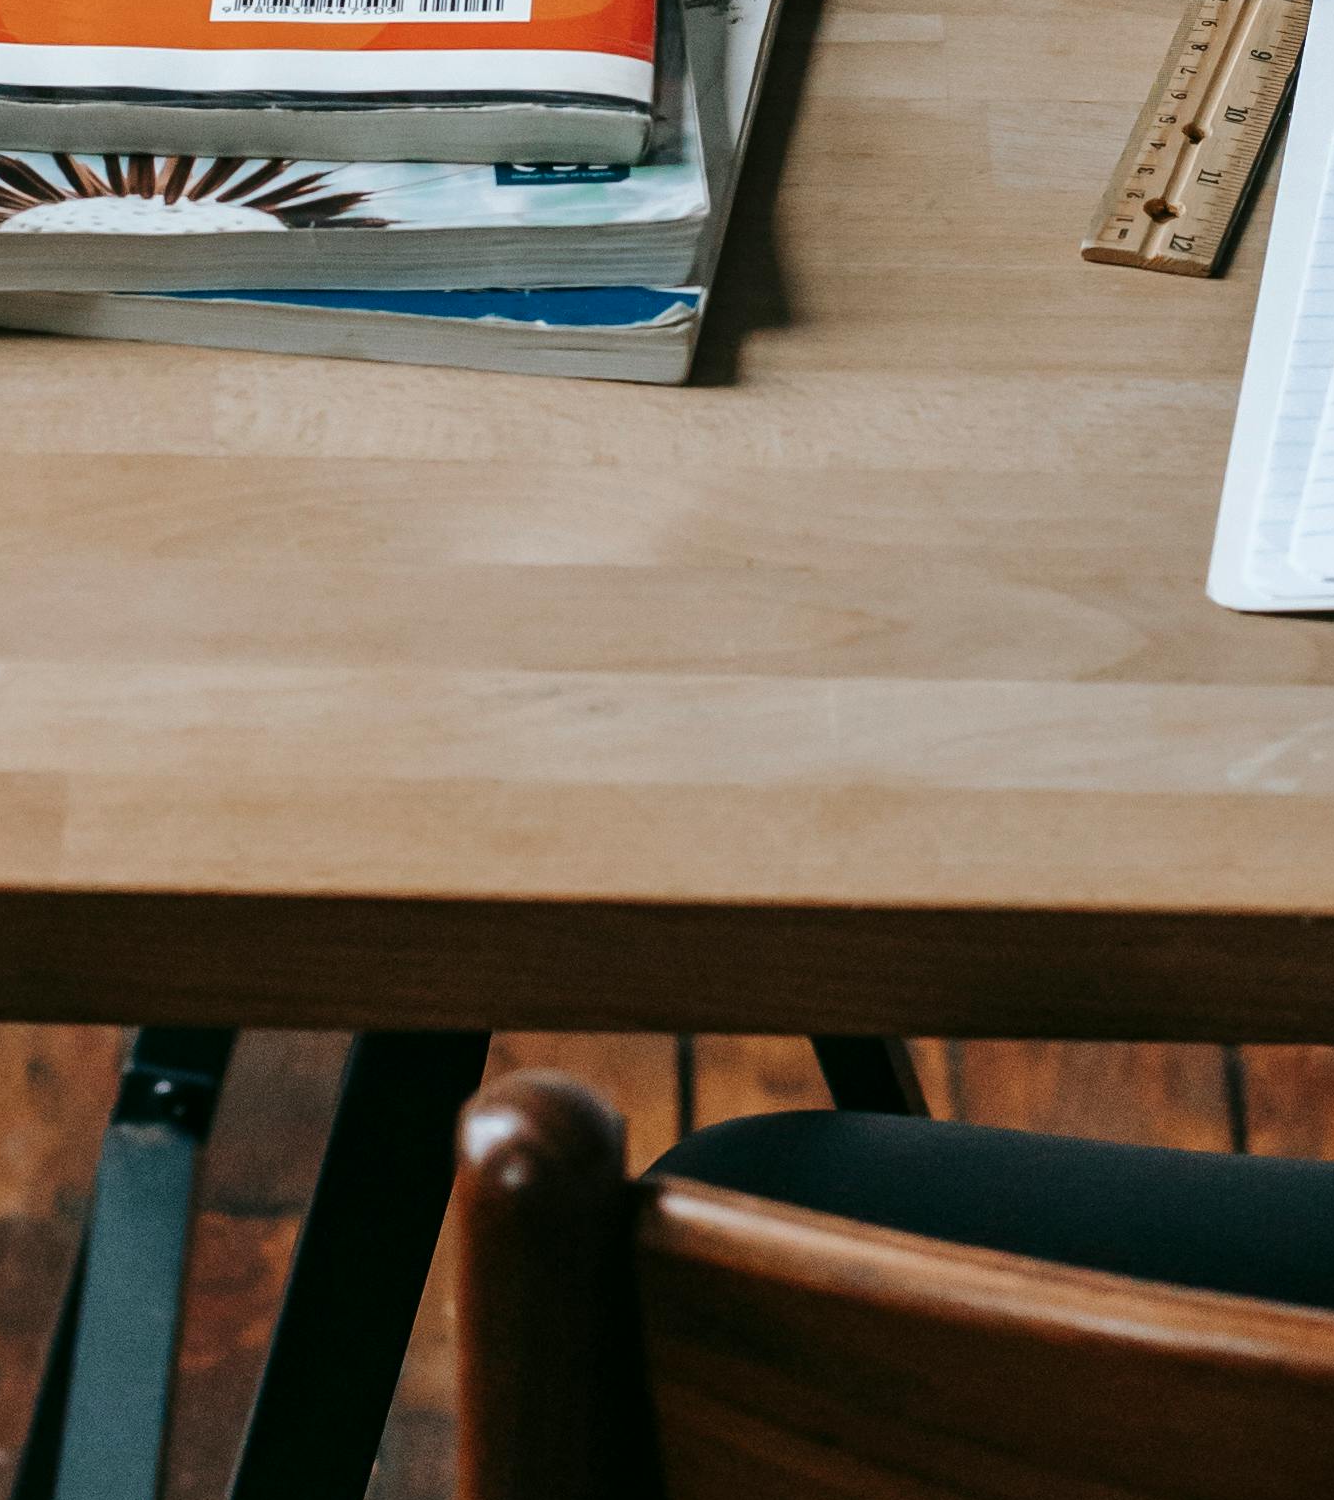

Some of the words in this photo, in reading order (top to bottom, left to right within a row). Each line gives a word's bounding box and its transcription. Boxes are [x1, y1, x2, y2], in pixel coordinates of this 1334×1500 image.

[1250, 49, 1273, 61] 9
[1137, 167, 1155, 176] 3
[1149, 140, 1166, 151] 4
[1159, 115, 1177, 125] 5
[1171, 91, 1187, 100] 6
[1181, 67, 1198, 76] 7
[1191, 43, 1209, 52] 8
[1201, 19, 1218, 28] 9
[1224, 105, 1249, 123] 10
[1197, 168, 1222, 185] 11
[1170, 233, 1195, 251] 12
